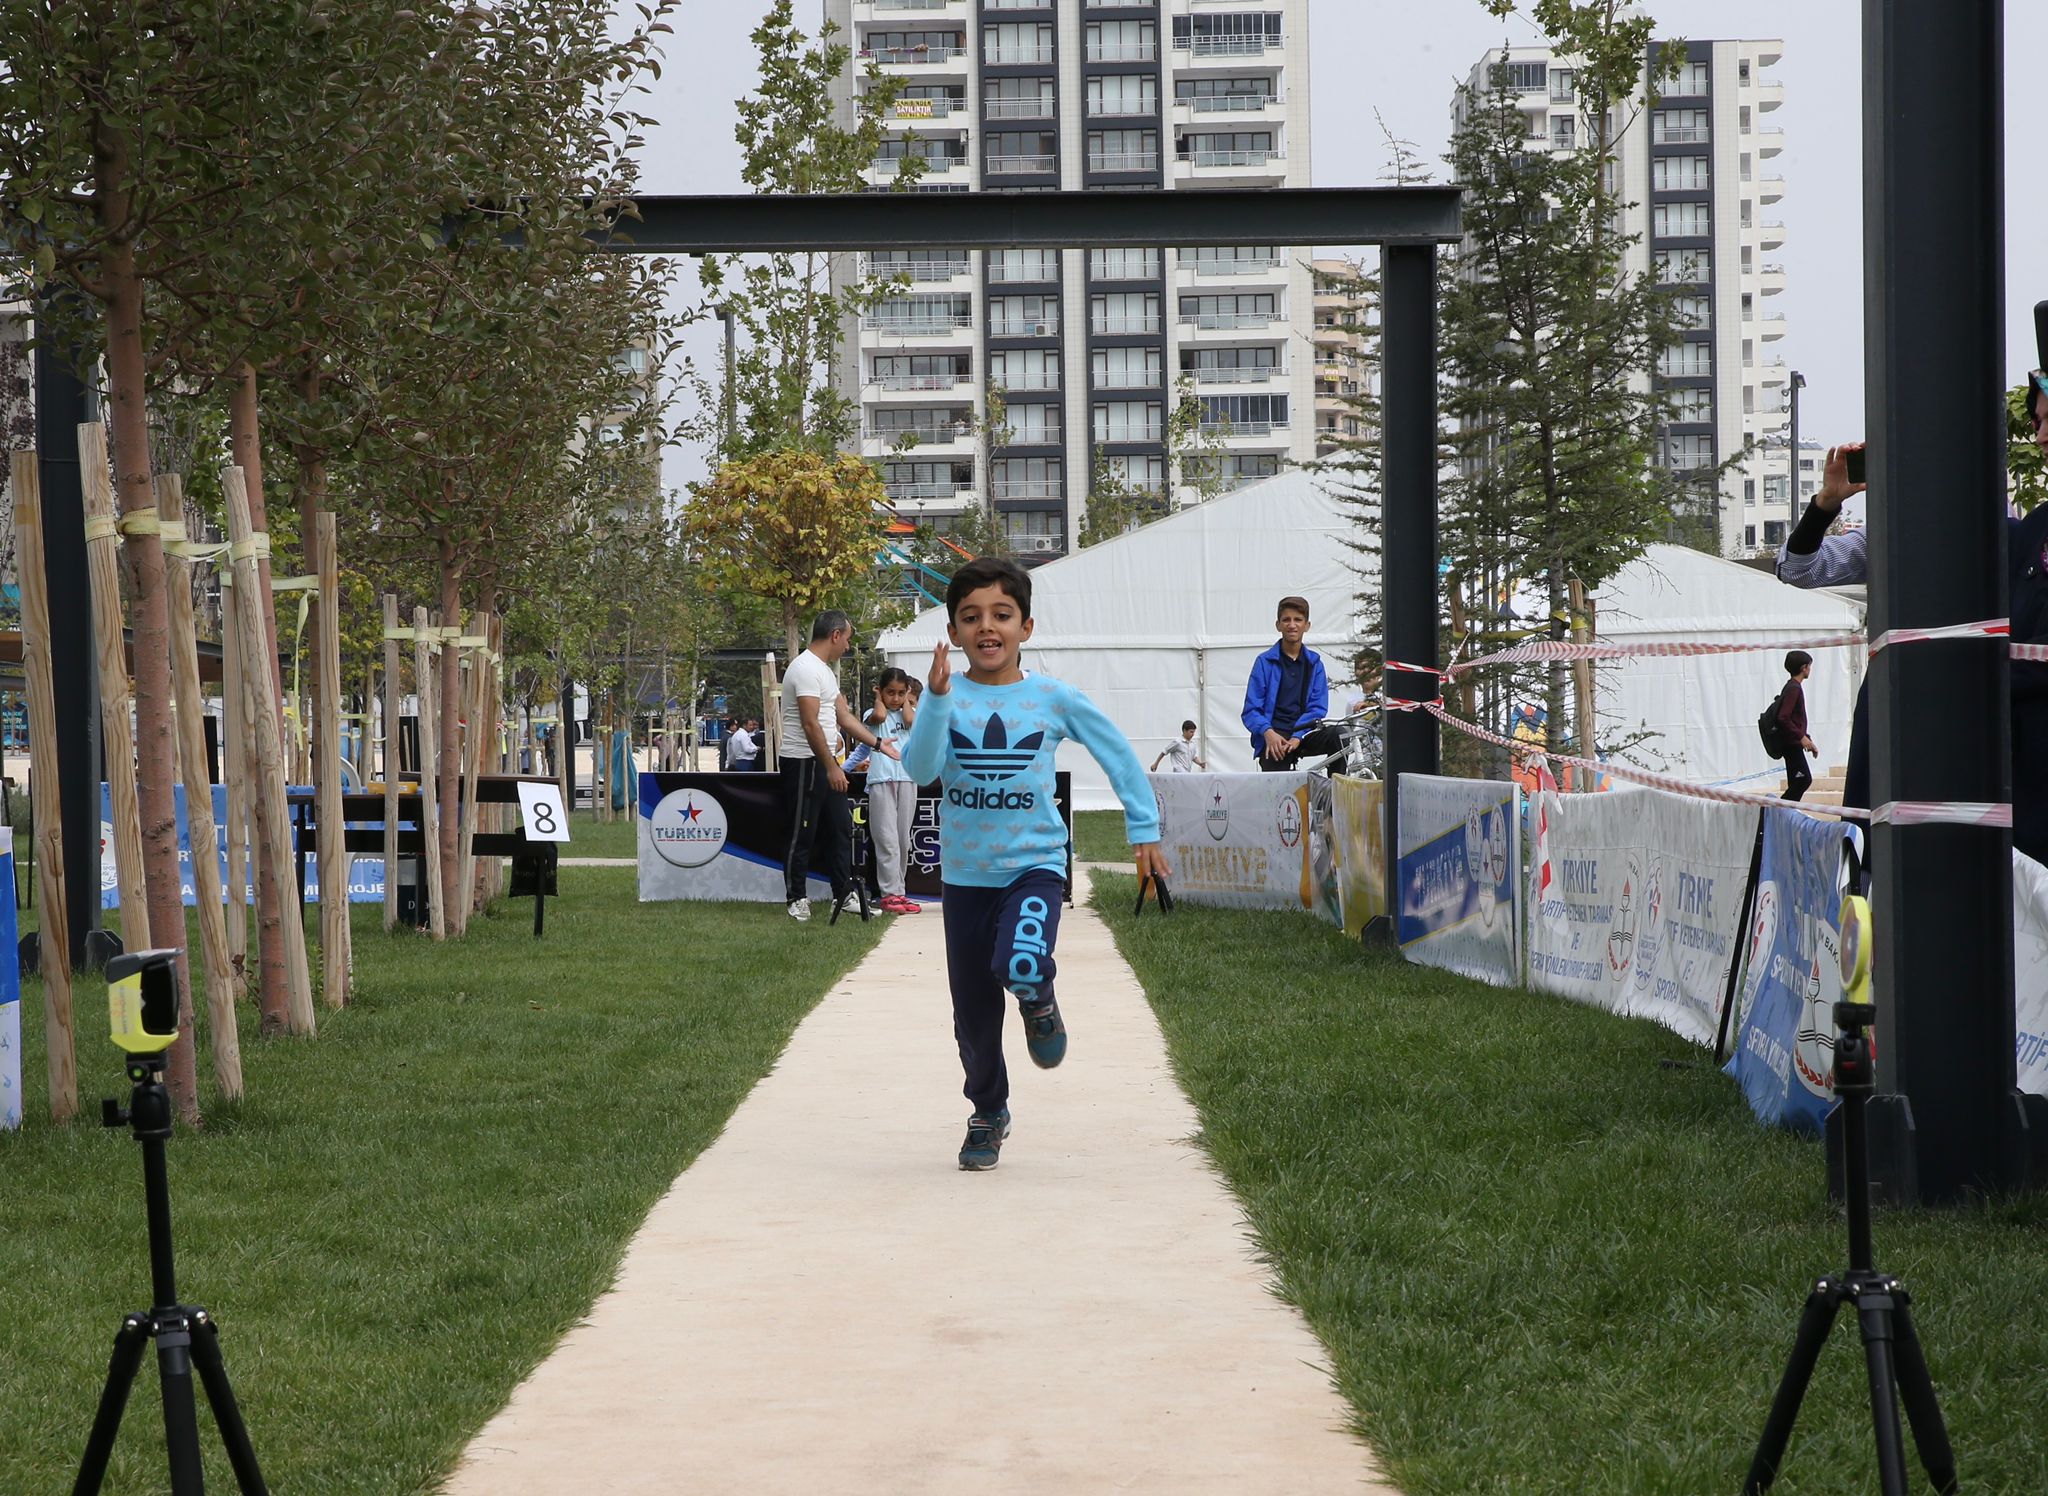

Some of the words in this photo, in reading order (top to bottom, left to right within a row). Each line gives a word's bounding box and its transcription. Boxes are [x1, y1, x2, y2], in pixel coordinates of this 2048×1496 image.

[948, 787, 1034, 809] adidas
[533, 802, 556, 833] 8
[656, 827, 722, 839] TÜRKİYE
[1008, 896, 1047, 1001] adida
